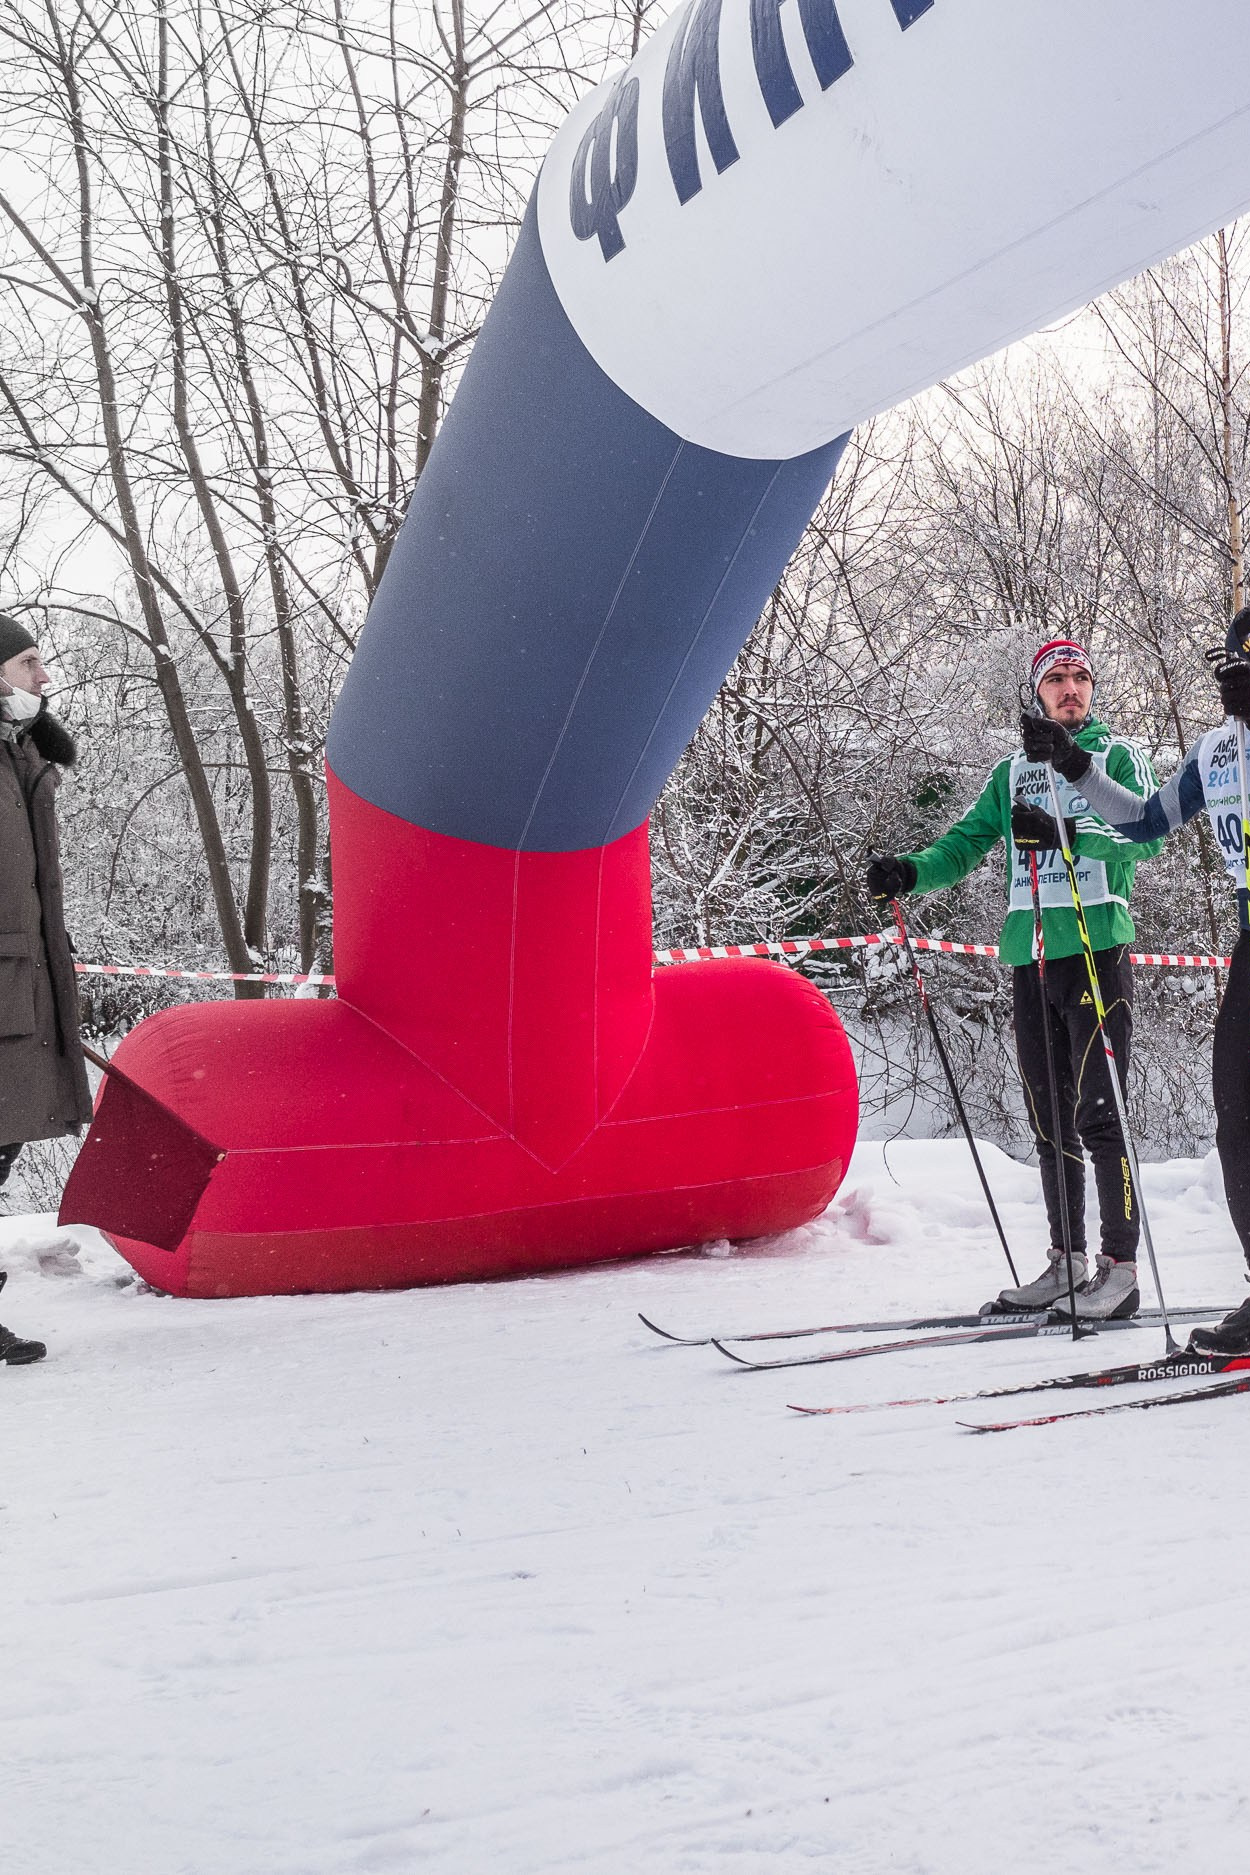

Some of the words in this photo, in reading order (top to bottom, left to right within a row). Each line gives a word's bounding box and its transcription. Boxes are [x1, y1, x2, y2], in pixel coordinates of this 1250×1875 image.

[1015, 768, 1049, 787] ЛЫЖН
[1021, 781, 1051, 797] ОССИИ
[1121, 1156, 1132, 1220] FISCHER
[980, 1315, 1021, 1325] START
[1138, 1361, 1216, 1381] ROSSIGNOL
